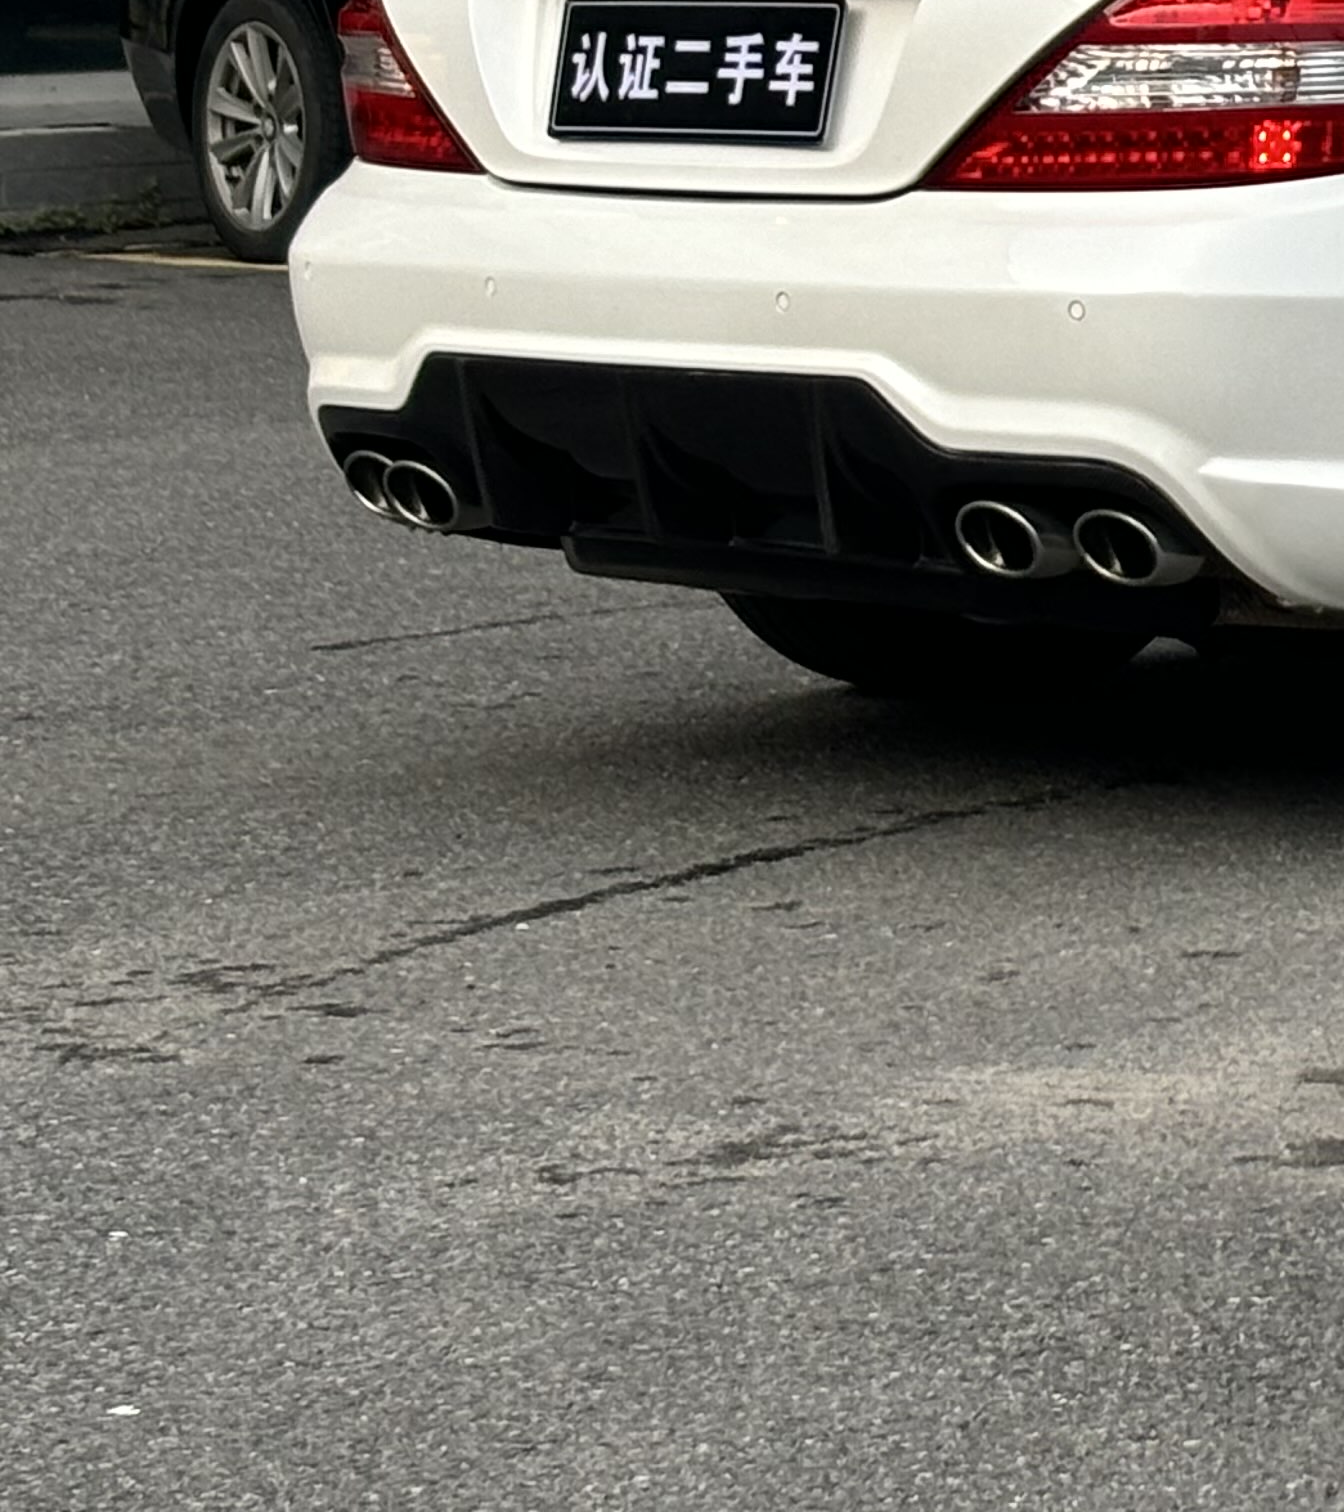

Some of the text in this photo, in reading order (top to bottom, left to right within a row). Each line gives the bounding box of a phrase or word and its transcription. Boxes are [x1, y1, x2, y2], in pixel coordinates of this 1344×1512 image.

[570, 31, 820, 107] 认证二手车
